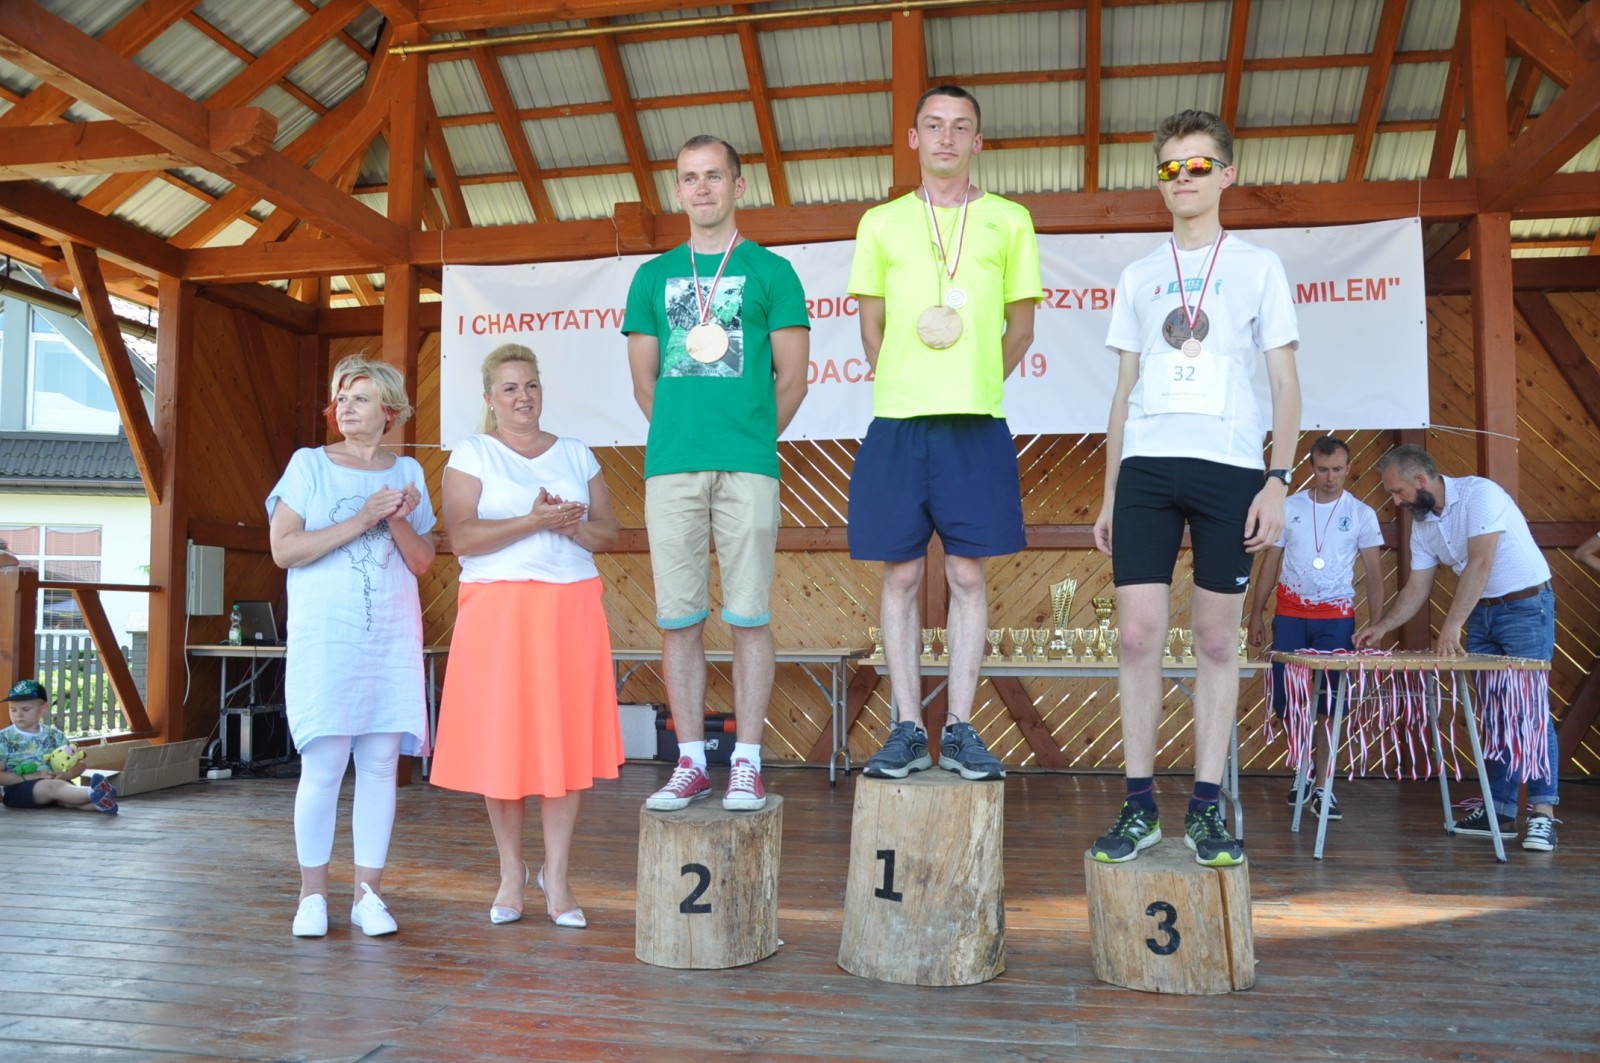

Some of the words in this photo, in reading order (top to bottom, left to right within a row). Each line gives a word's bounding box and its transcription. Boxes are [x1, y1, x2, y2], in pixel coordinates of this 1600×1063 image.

[458, 315, 464, 335] I
[1292, 277, 1400, 304] MILEM"
[1173, 365, 1195, 381] 32
[679, 863, 712, 914] 2
[874, 849, 903, 903] 1
[1145, 900, 1181, 956] 3
